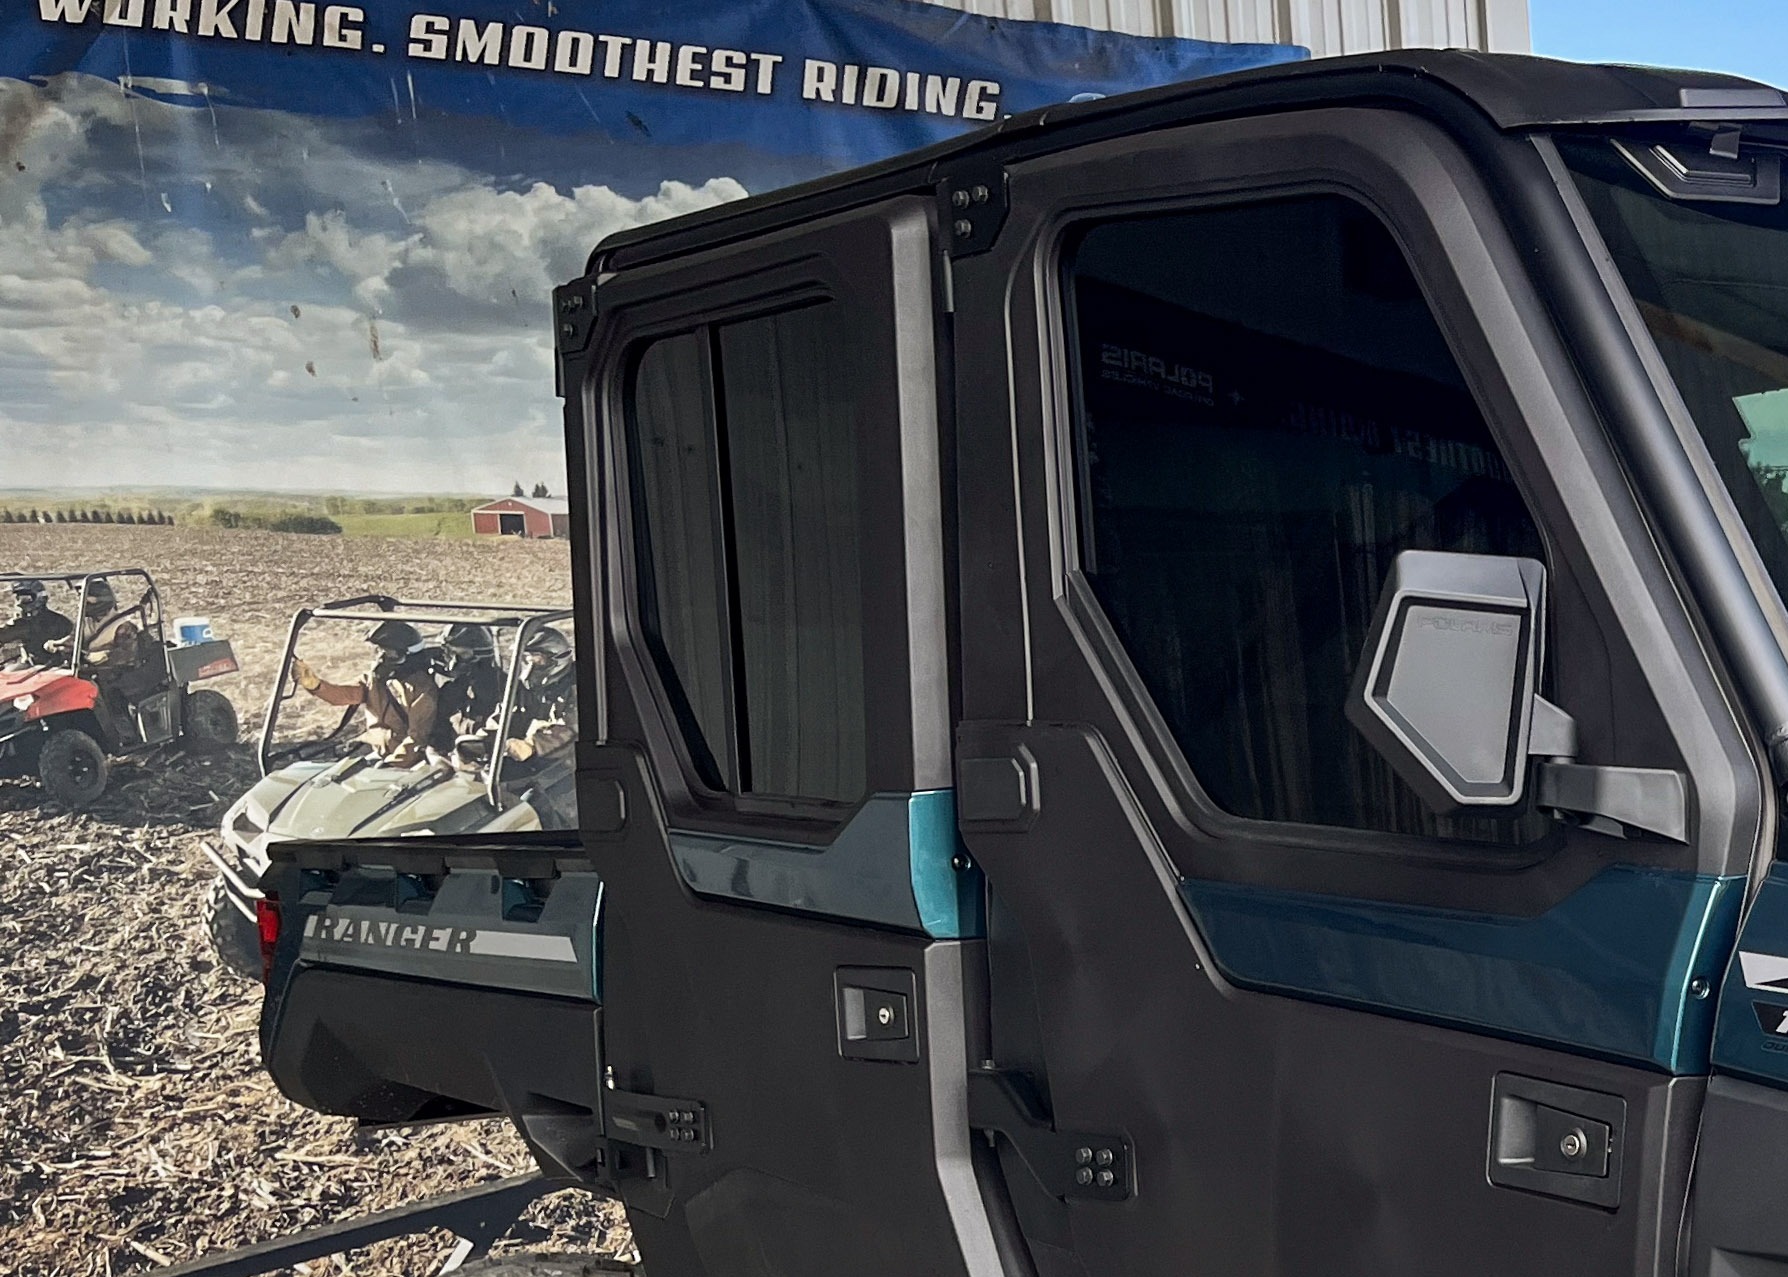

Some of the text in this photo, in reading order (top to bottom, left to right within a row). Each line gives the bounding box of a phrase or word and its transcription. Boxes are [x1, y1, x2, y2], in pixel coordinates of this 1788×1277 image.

[39, 0, 386, 53] WORKING.
[407, 13, 783, 95] SMOOTHEST
[311, 913, 478, 954] RANGER
